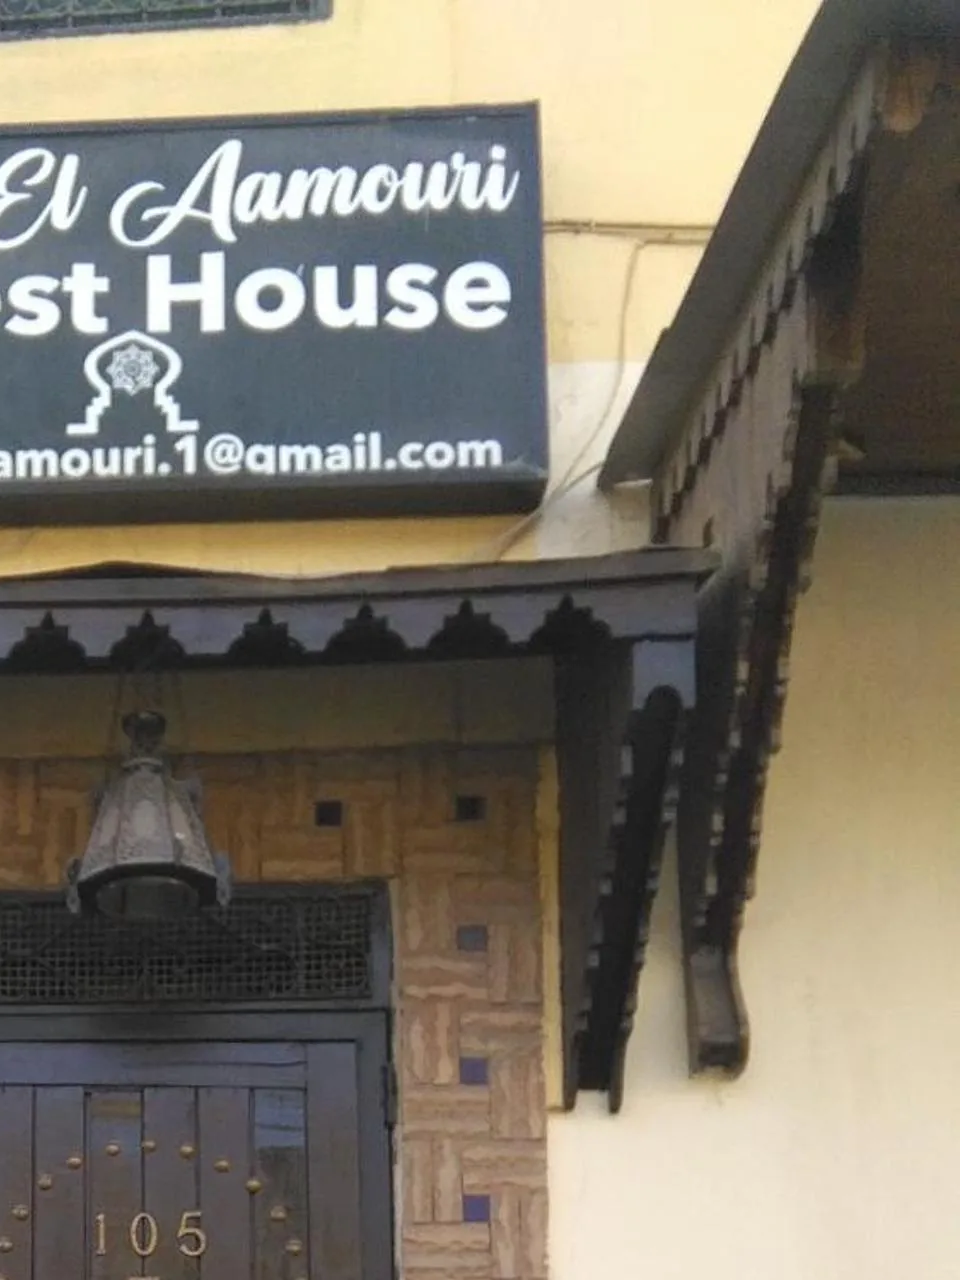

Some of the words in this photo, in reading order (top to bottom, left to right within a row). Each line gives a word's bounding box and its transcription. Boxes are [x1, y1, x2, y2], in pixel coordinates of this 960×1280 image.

[109, 138, 520, 248] Aamouri
[146, 251, 512, 334] House
[96, 1211, 207, 1256] 105
